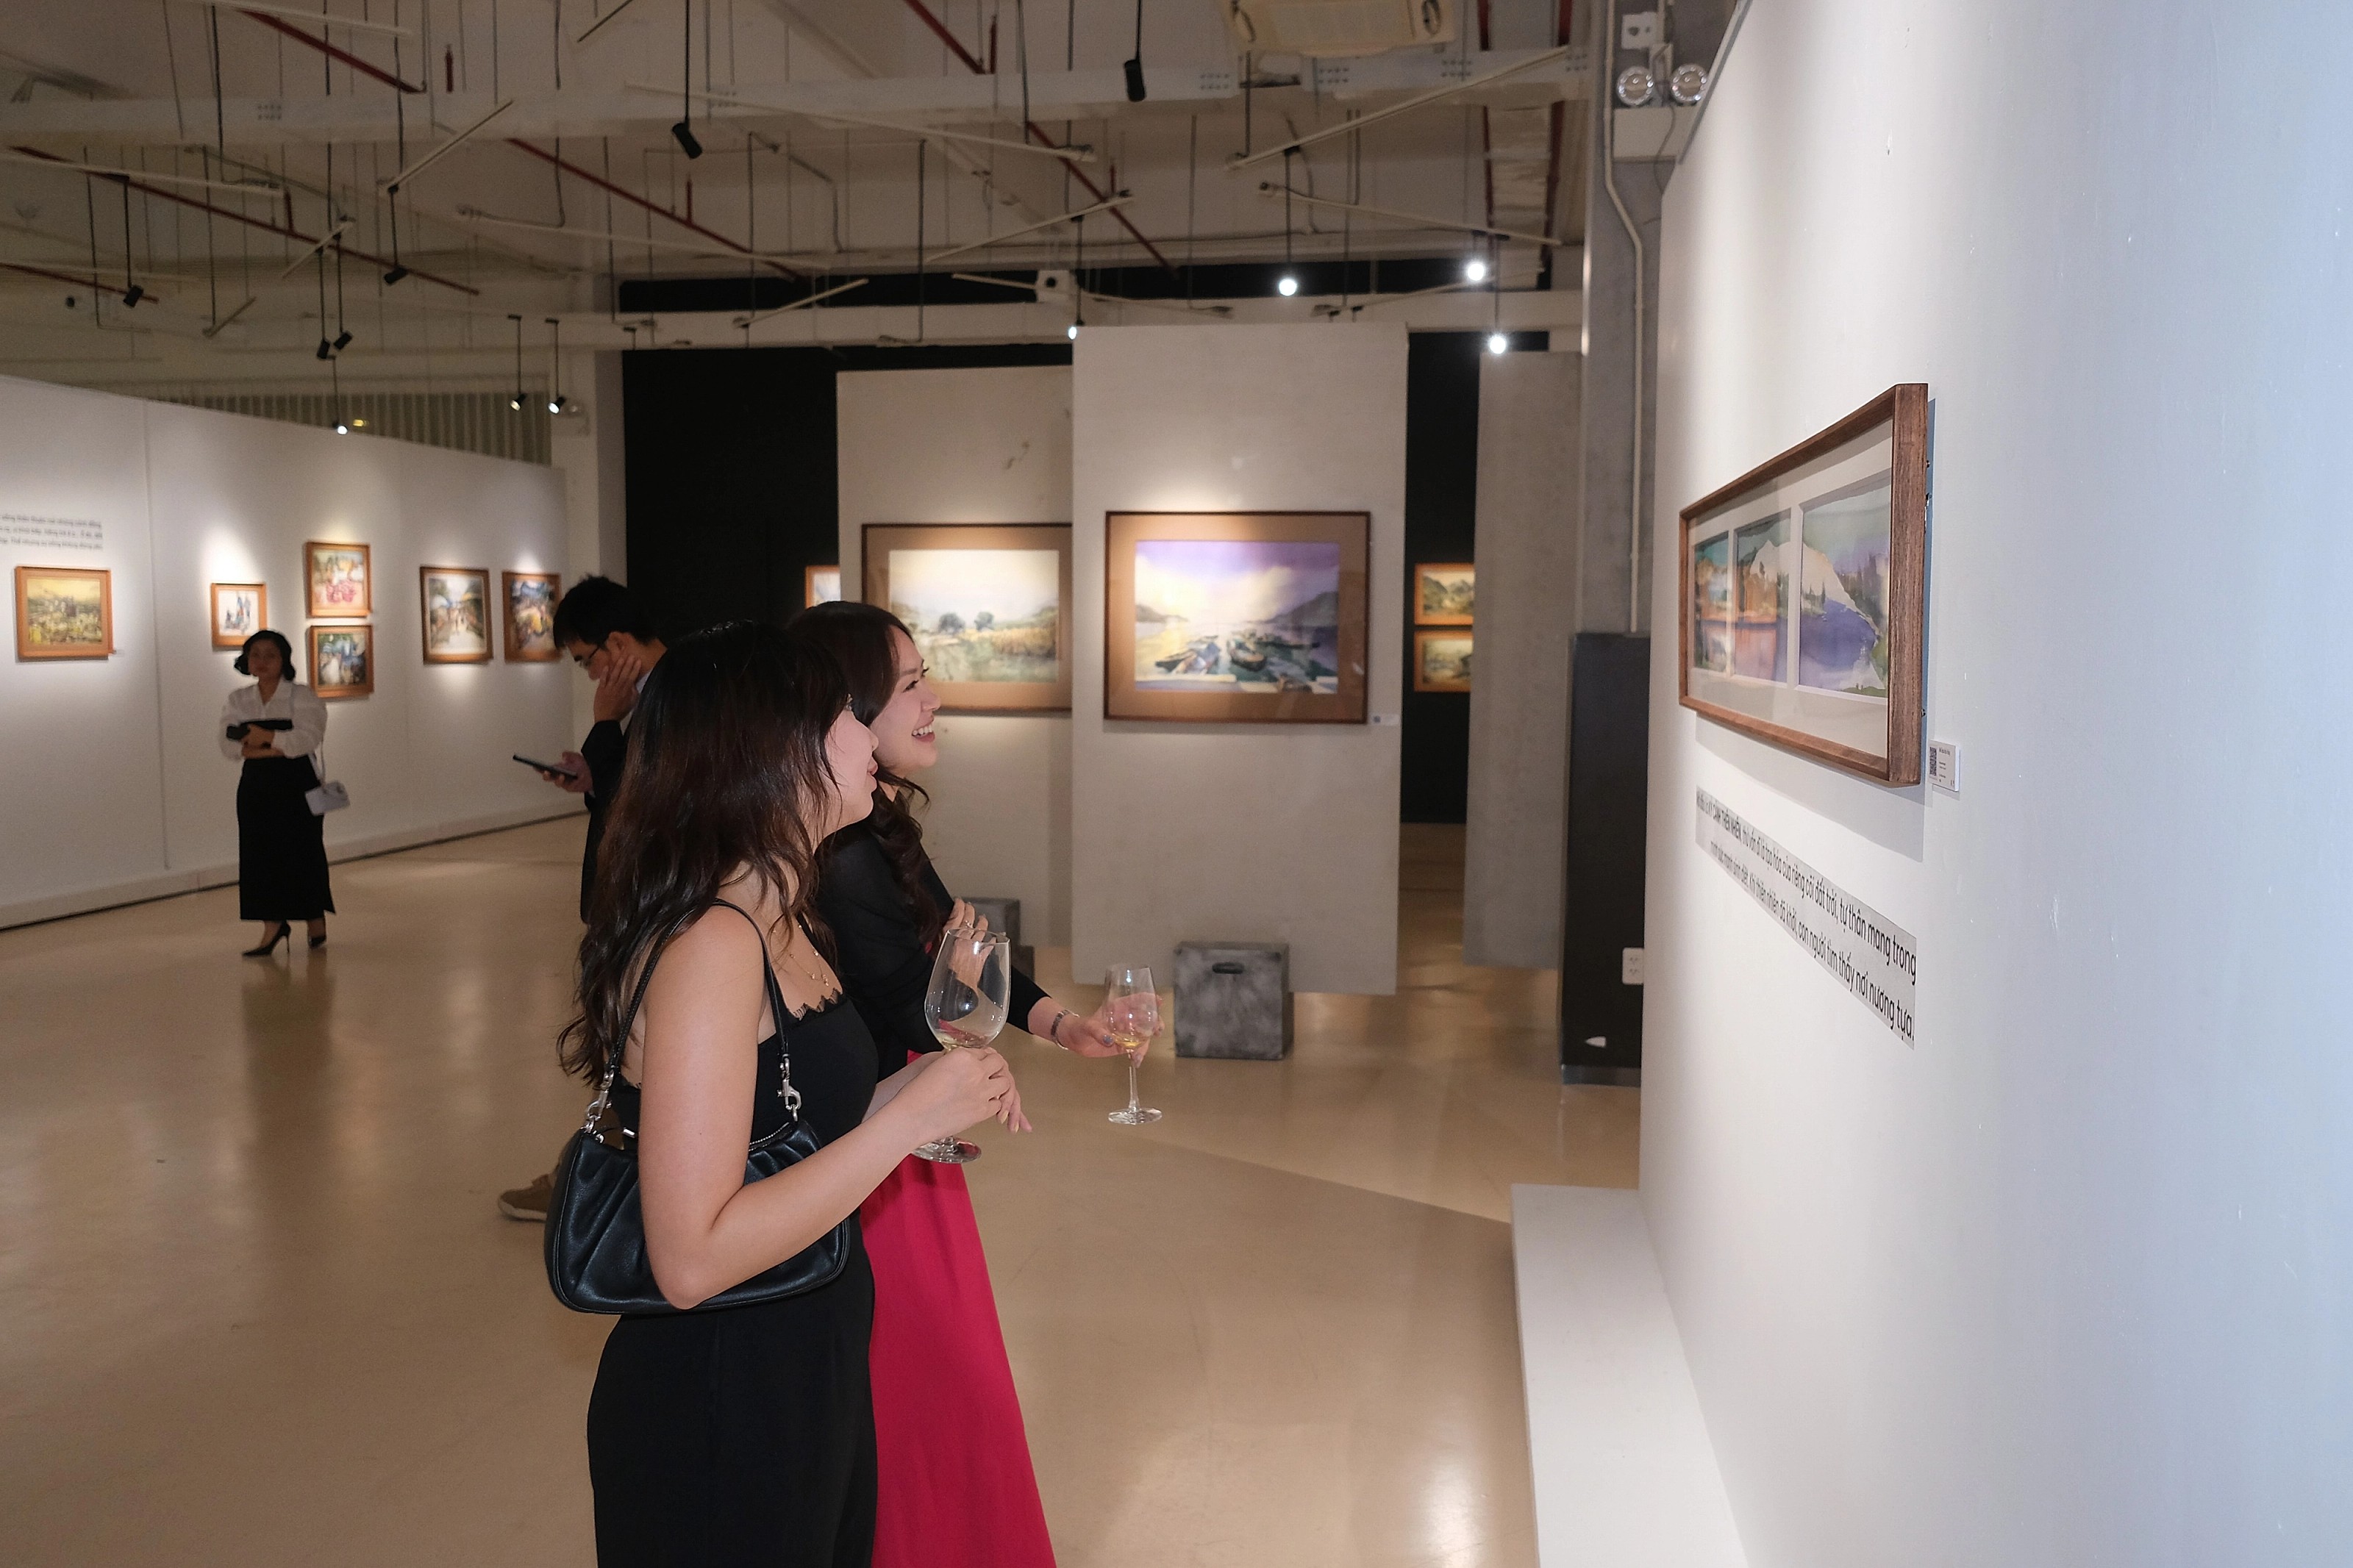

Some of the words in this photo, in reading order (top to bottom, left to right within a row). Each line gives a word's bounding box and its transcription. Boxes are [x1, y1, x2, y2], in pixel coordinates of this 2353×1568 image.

[1721, 809, 1729, 831] THIÊN
[1782, 855, 1790, 881] của
[1791, 863, 1804, 898] riêng
[1805, 875, 1814, 900] cõi
[1814, 877, 1825, 909] đất
[1826, 887, 1838, 923] trời,
[1840, 898, 1848, 932] tự
[1849, 903, 1865, 939] thân
[1867, 923, 1890, 965] mang
[1893, 934, 1915, 985] trong
[1756, 878, 1765, 903] thiên
[1766, 888, 1779, 916] nhiên
[1779, 899, 1785, 923] đã
[1798, 921, 1808, 945] con
[1809, 931, 1826, 960] người
[1827, 939, 1837, 971] tìm
[1838, 951, 1854, 991] thấy
[1855, 970, 1868, 998] nơi
[1869, 983, 1894, 1029] nương
[1896, 999, 1914, 1045] tựa.
